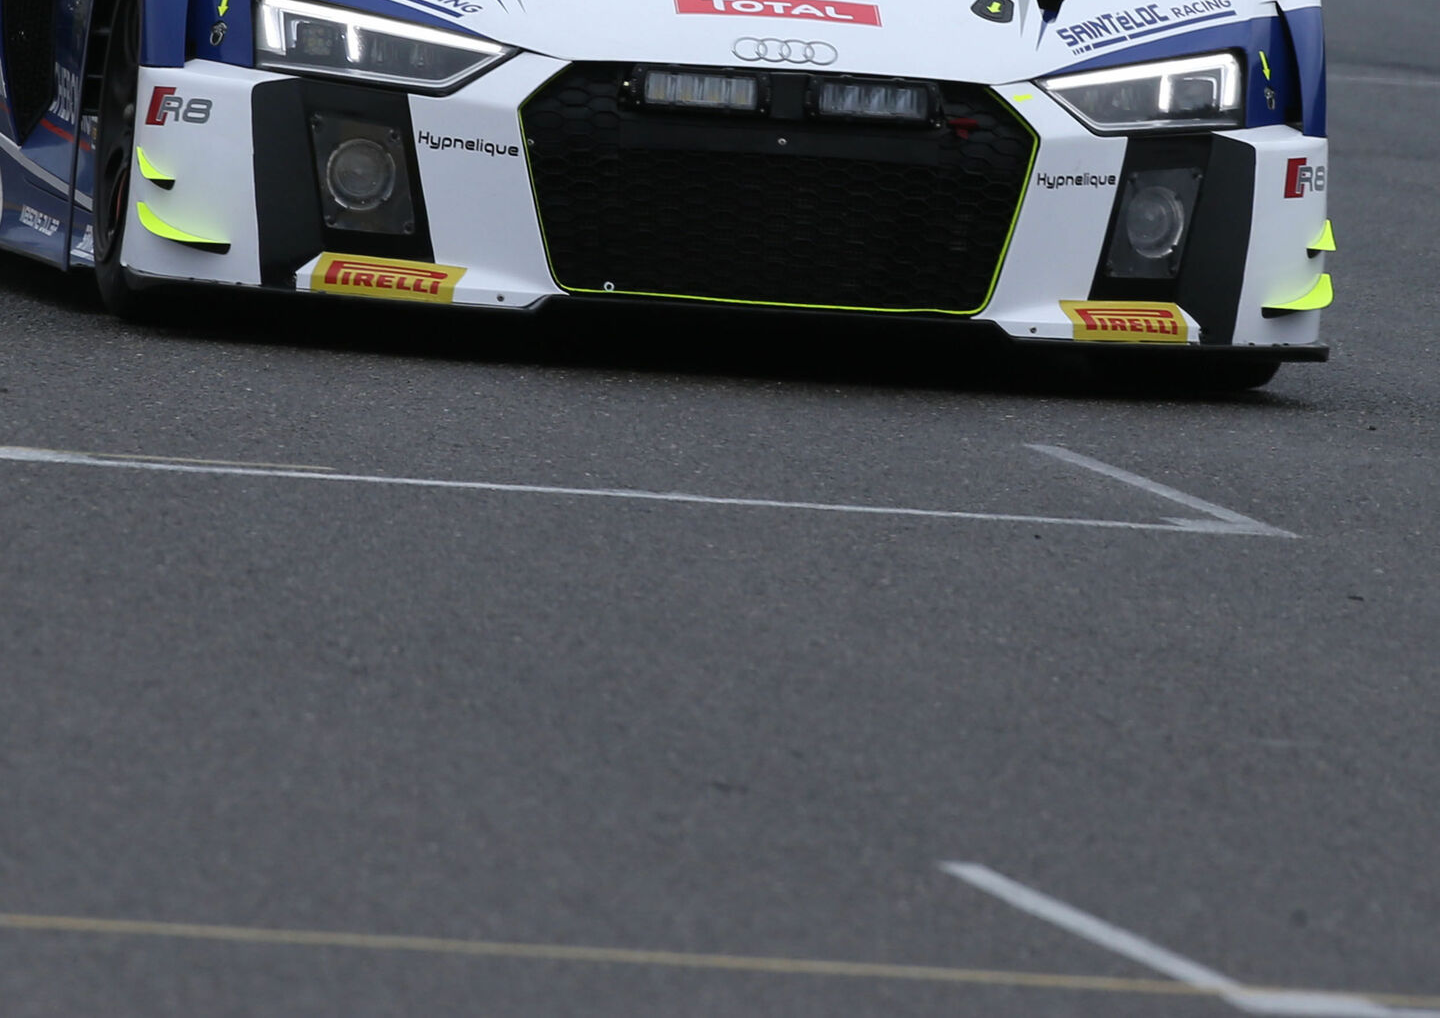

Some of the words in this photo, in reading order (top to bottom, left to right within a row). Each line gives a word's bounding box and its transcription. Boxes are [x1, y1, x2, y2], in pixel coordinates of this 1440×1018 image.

[154, 93, 213, 124] R8
[417, 130, 520, 158] Hypnelique
[1036, 171, 1117, 190] Hypnelique
[1294, 164, 1325, 194] R8
[324, 259, 449, 296] PIRELLI
[1073, 307, 1179, 336] PIRELLI
